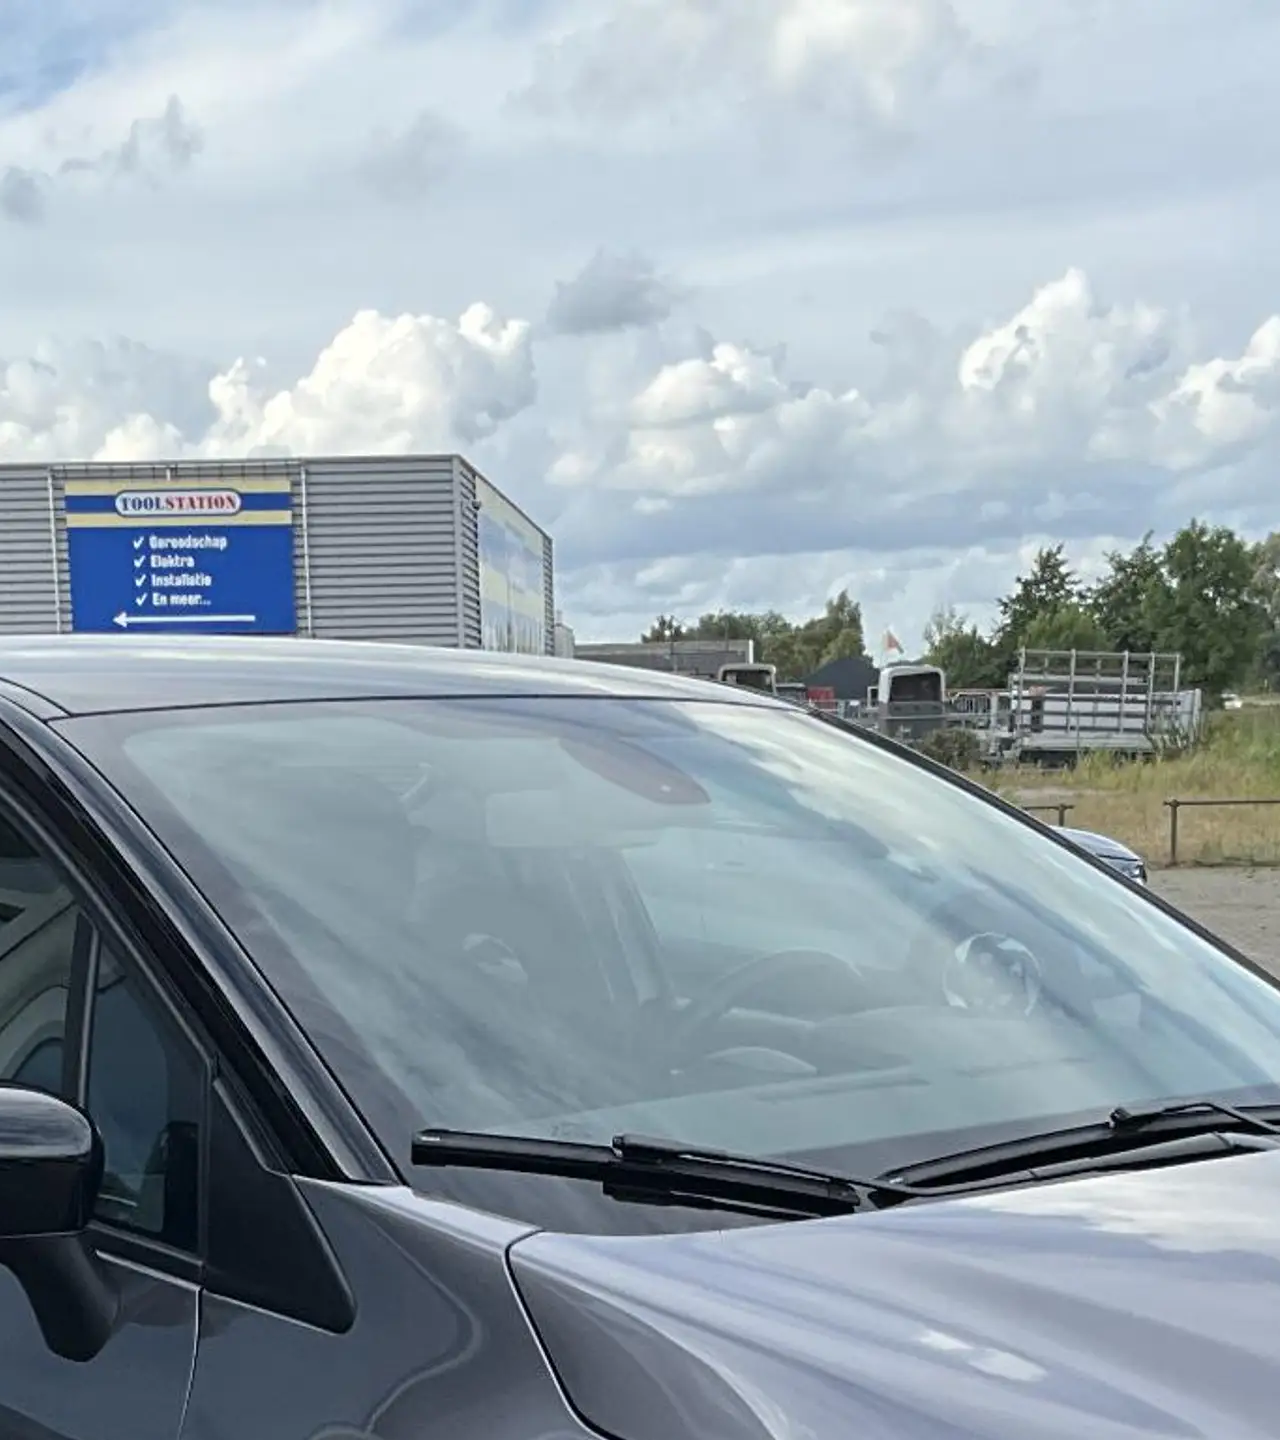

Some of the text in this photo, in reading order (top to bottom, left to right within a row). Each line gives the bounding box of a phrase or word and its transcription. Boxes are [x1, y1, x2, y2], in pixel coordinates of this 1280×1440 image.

[119, 494, 237, 512] TOOLSTATION
[148, 534, 228, 551] Gereedschap
[150, 554, 195, 568] Elektra
[151, 572, 213, 588] Installatie
[152, 593, 168, 605] En
